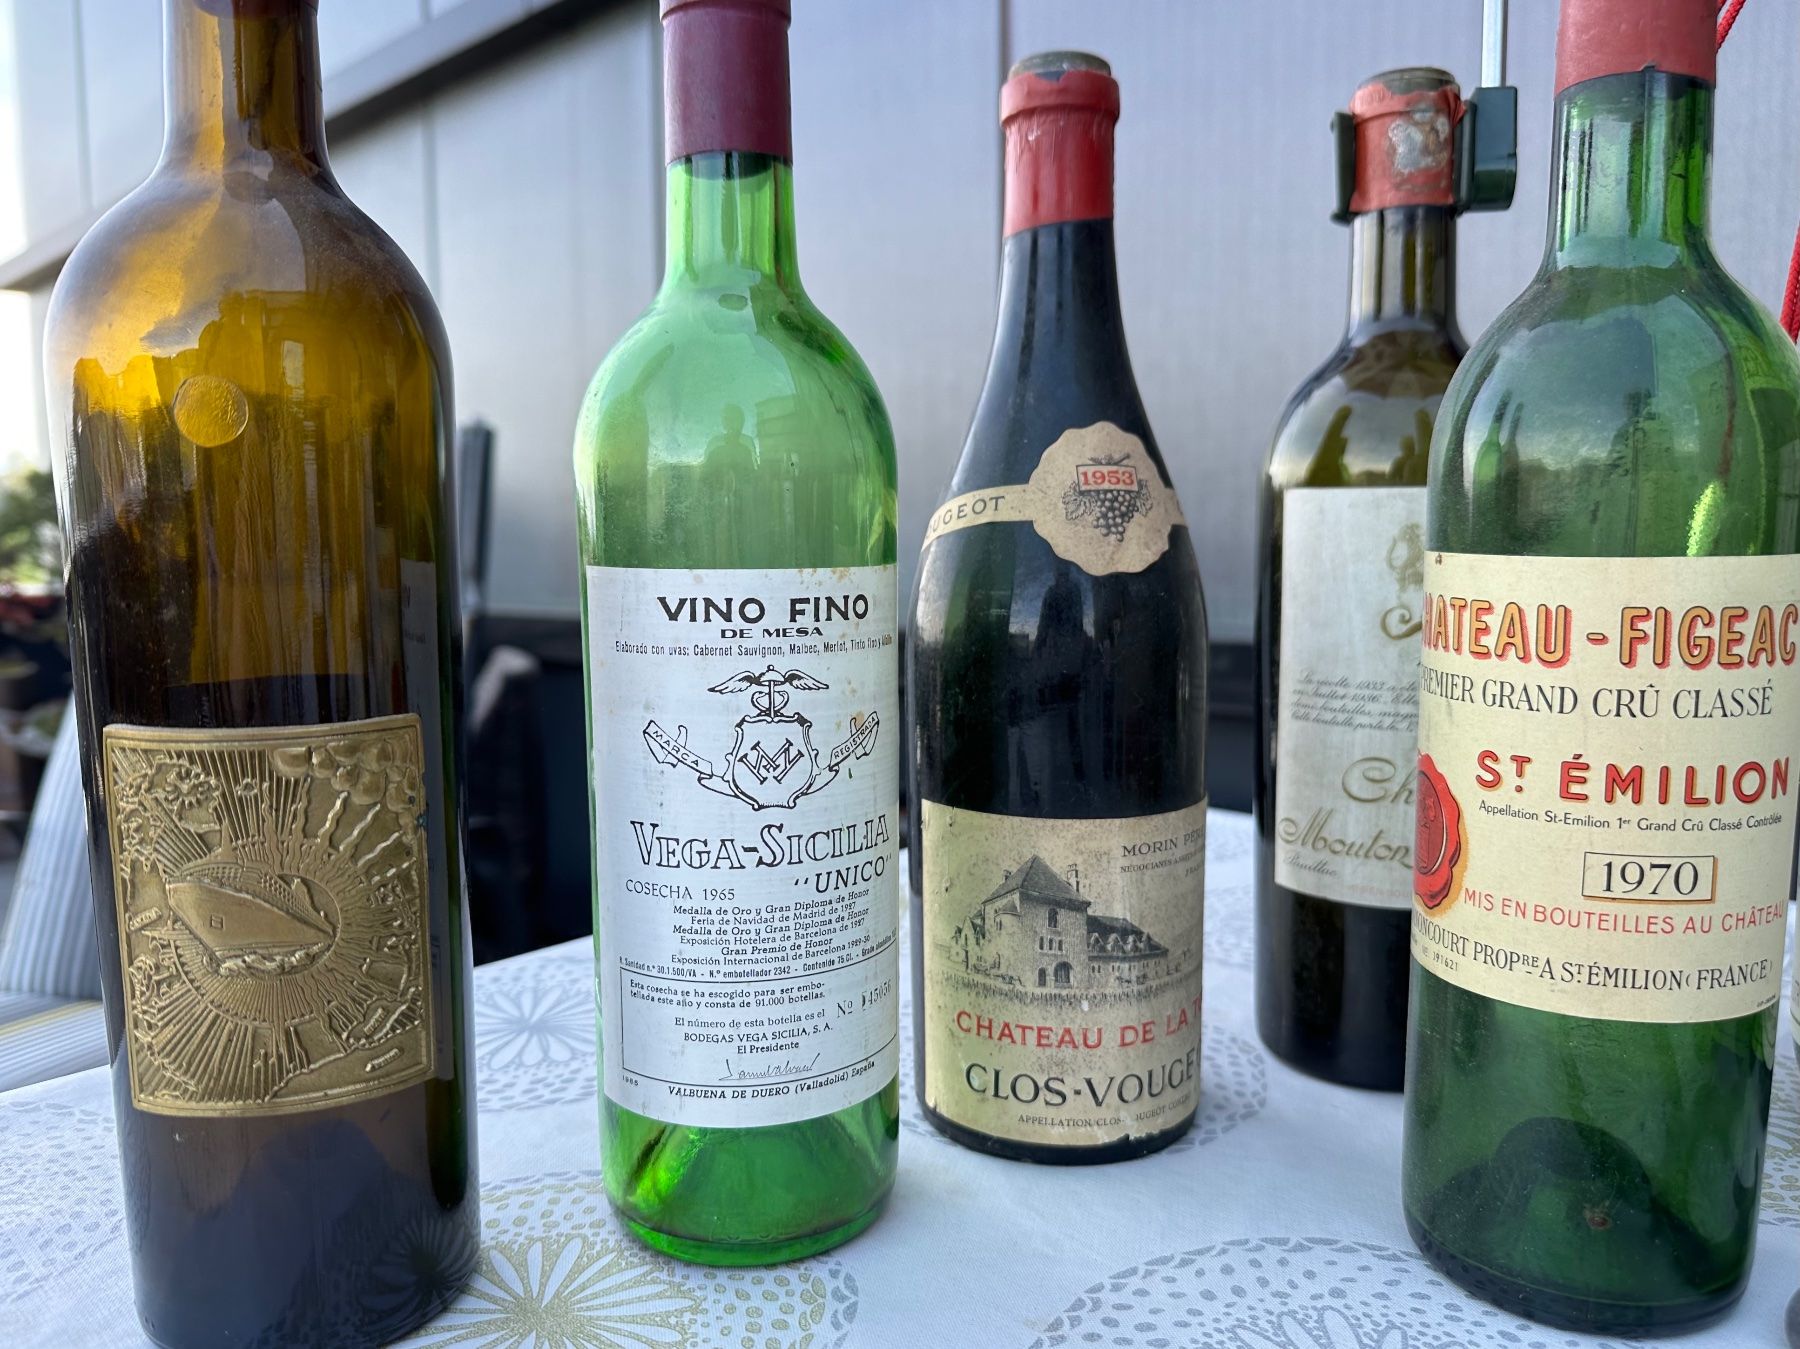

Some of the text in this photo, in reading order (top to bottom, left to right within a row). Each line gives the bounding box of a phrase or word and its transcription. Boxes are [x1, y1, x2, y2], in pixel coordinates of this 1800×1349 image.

[1081, 470, 1135, 487] 1953
[656, 593, 869, 624] VINO FINO
[720, 626, 824, 639] DE MESA
[1422, 591, 1572, 668] HATEAU
[1618, 602, 1799, 670] FIGEAC
[615, 640, 648, 655] Elaborado
[651, 645, 665, 656] con
[693, 644, 733, 656] Cabernet
[737, 643, 785, 658] Sauvignon,
[789, 642, 820, 657] Malbec,
[823, 639, 848, 653] Merlot,
[1481, 678, 1579, 715] GRAND
[1591, 683, 1660, 719] CRÛ
[1672, 678, 1774, 719] CLASSÉ
[651, 729, 700, 767] MARCA
[832, 714, 877, 759] REGISTRADA
[1558, 753, 1790, 809] ÉMILION
[1478, 799, 1539, 821] Appellation
[1544, 810, 1610, 829] St-Emilion
[1637, 817, 1676, 832] Grand
[1681, 817, 1704, 832] Crû
[1709, 817, 1743, 831] Classé
[1746, 811, 1783, 829] Contrôlée
[1121, 837, 1178, 857] MORIN
[625, 878, 736, 901] COSECHA 1965
[1600, 860, 1699, 896] 1970
[673, 888, 870, 916] Medalla de Oro y Gran Diploma de Honor
[690, 901, 856, 926] Feria de Navidad de Madrid de 1927
[1463, 887, 1784, 935] MIS EN BOUTEILLES AU CHÂTEAU
[672, 907, 870, 937] Medalla de Oro y Gran Diploma de Honor
[680, 917, 865, 947] Exposición Hotelera de Barcelona de 1927
[671, 953, 720, 966] Exposición
[723, 952, 790, 966] Internacional
[791, 950, 803, 961] de
[805, 944, 846, 959] Barcelona
[721, 937, 834, 956] Gran Premio de Honor
[722, 968, 771, 979] embotellador
[773, 965, 791, 976] 2342
[803, 958, 835, 972] Contenido
[1538, 957, 1556, 981] A
[630, 978, 645, 989] Esta
[646, 985, 678, 996] cosecha
[693, 988, 706, 998] ha
[708, 988, 751, 1000] escogido
[753, 989, 776, 999] para
[780, 986, 795, 995] ser
[797, 981, 825, 992] embo-
[630, 989, 655, 1002] tellada
[657, 996, 674, 1005] este
[695, 1001, 702, 1010] y
[704, 1000, 736, 1009] consta
[739, 999, 751, 1008] de
[755, 996, 785, 1008] 91.000
[788, 991, 826, 1004] botellas.
[674, 1008, 825, 1029] El número de esta botella es el
[955, 1009, 1104, 1050] CHATEAU
[1118, 1020, 1156, 1048] DE
[1165, 1006, 1190, 1036] LA
[683, 1021, 833, 1044] BODEGAS VEGA SICILIA, S. A.
[736, 1040, 800, 1055] El Presidente
[668, 1059, 876, 1099] VALBUENA DE DUERO (Valladolid) España
[1017, 1113, 1093, 1128] APPELLATION
